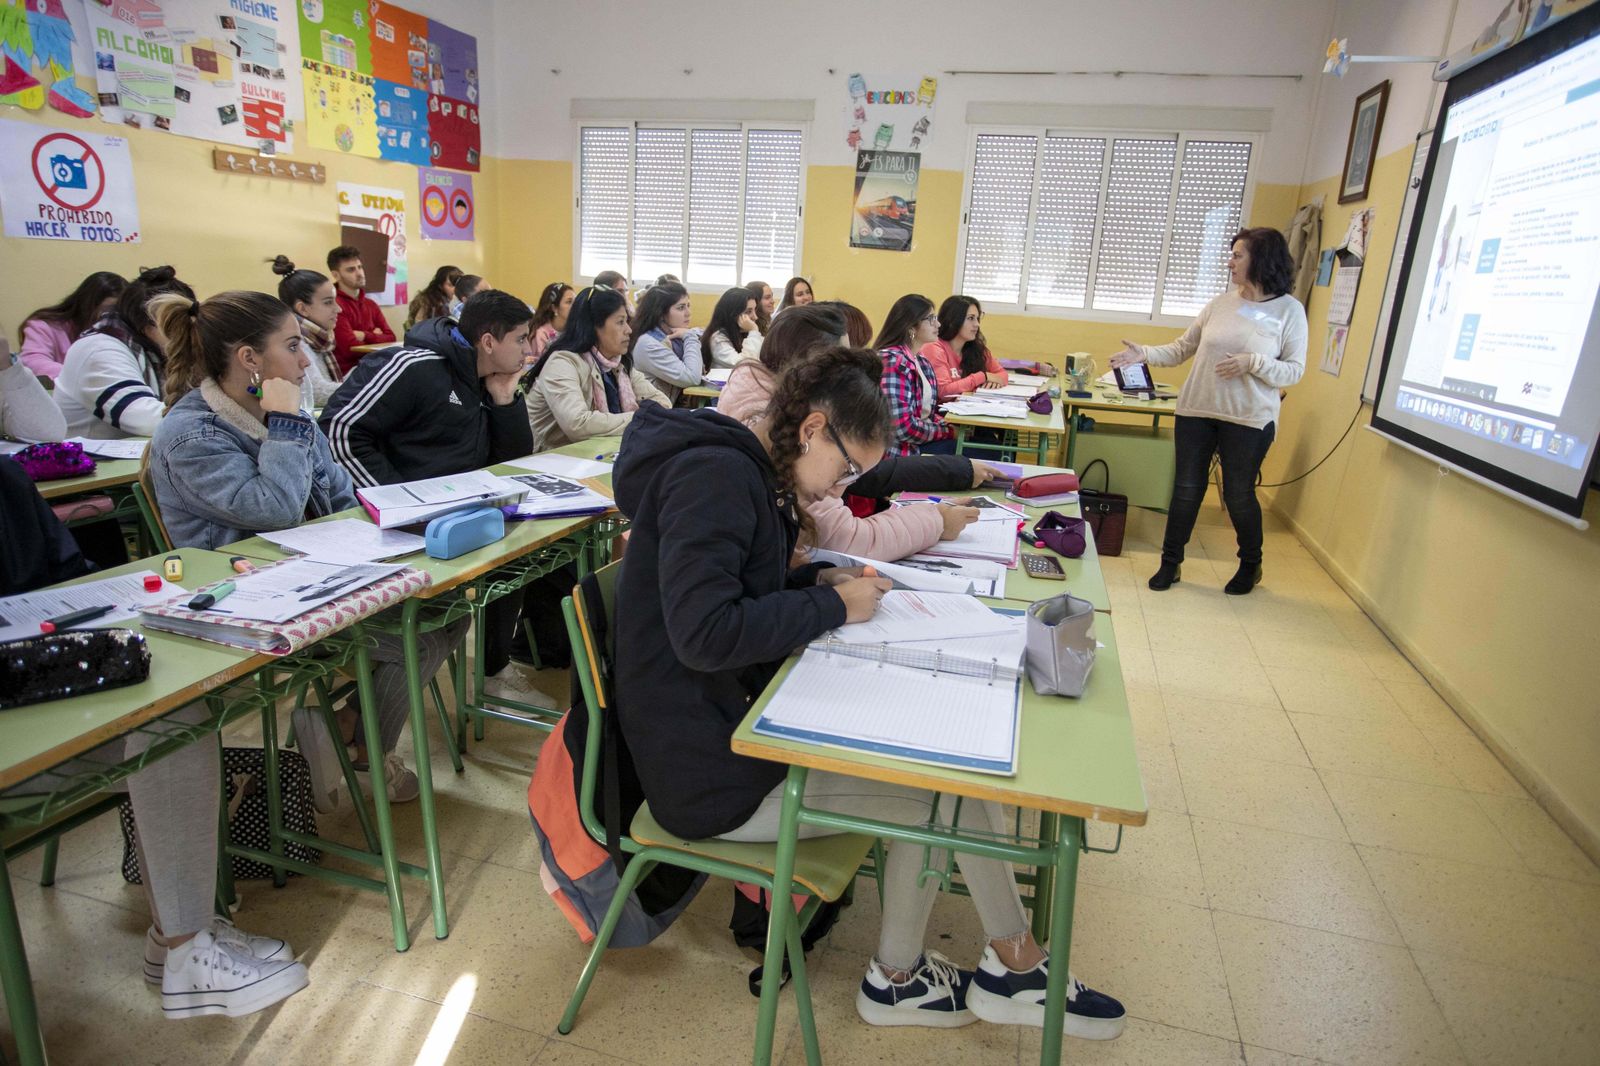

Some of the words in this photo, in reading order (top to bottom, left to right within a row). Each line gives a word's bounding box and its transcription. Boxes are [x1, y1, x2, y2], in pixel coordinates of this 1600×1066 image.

[241, 81, 286, 103] BULLYING
[867, 90, 915, 104] EMOCIONES
[885, 155, 905, 171] PARA
[909, 156, 916, 170] TI
[38, 203, 113, 226] PROHIBIDO
[25, 221, 70, 239] HACER
